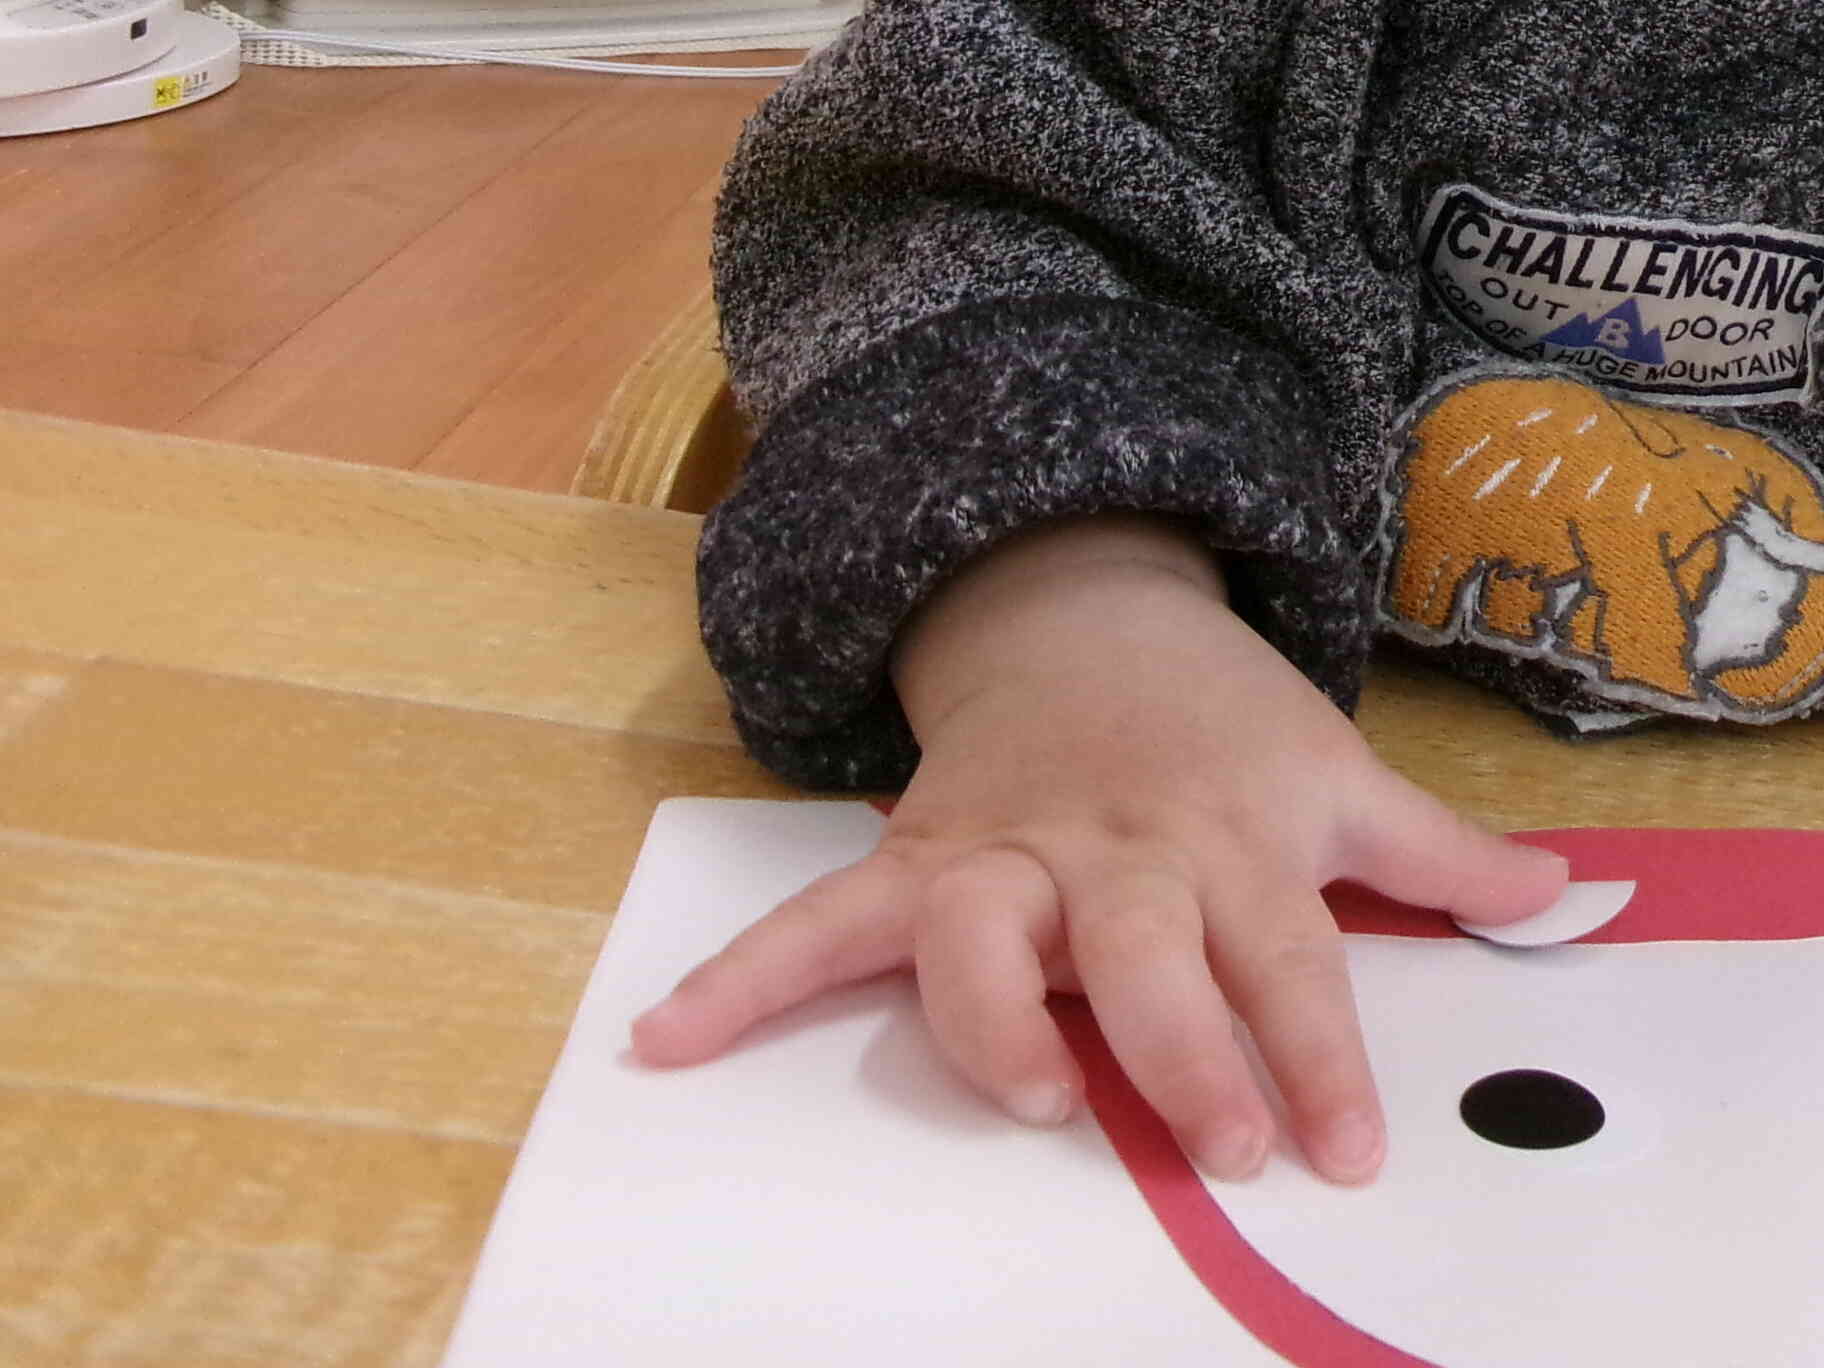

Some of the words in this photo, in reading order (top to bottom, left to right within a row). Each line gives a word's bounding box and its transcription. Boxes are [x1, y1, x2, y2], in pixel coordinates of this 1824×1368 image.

[1448, 212, 1824, 314] CHALLENGING
[1480, 277, 1570, 320] OUT
[1665, 316, 1775, 346] DOOR
[1594, 318, 1631, 349] B
[1485, 319, 1528, 340] OF
[1519, 341, 1547, 359] A
[1552, 348, 1640, 379] HUGE
[1644, 344, 1799, 382] MOUNTAIN
